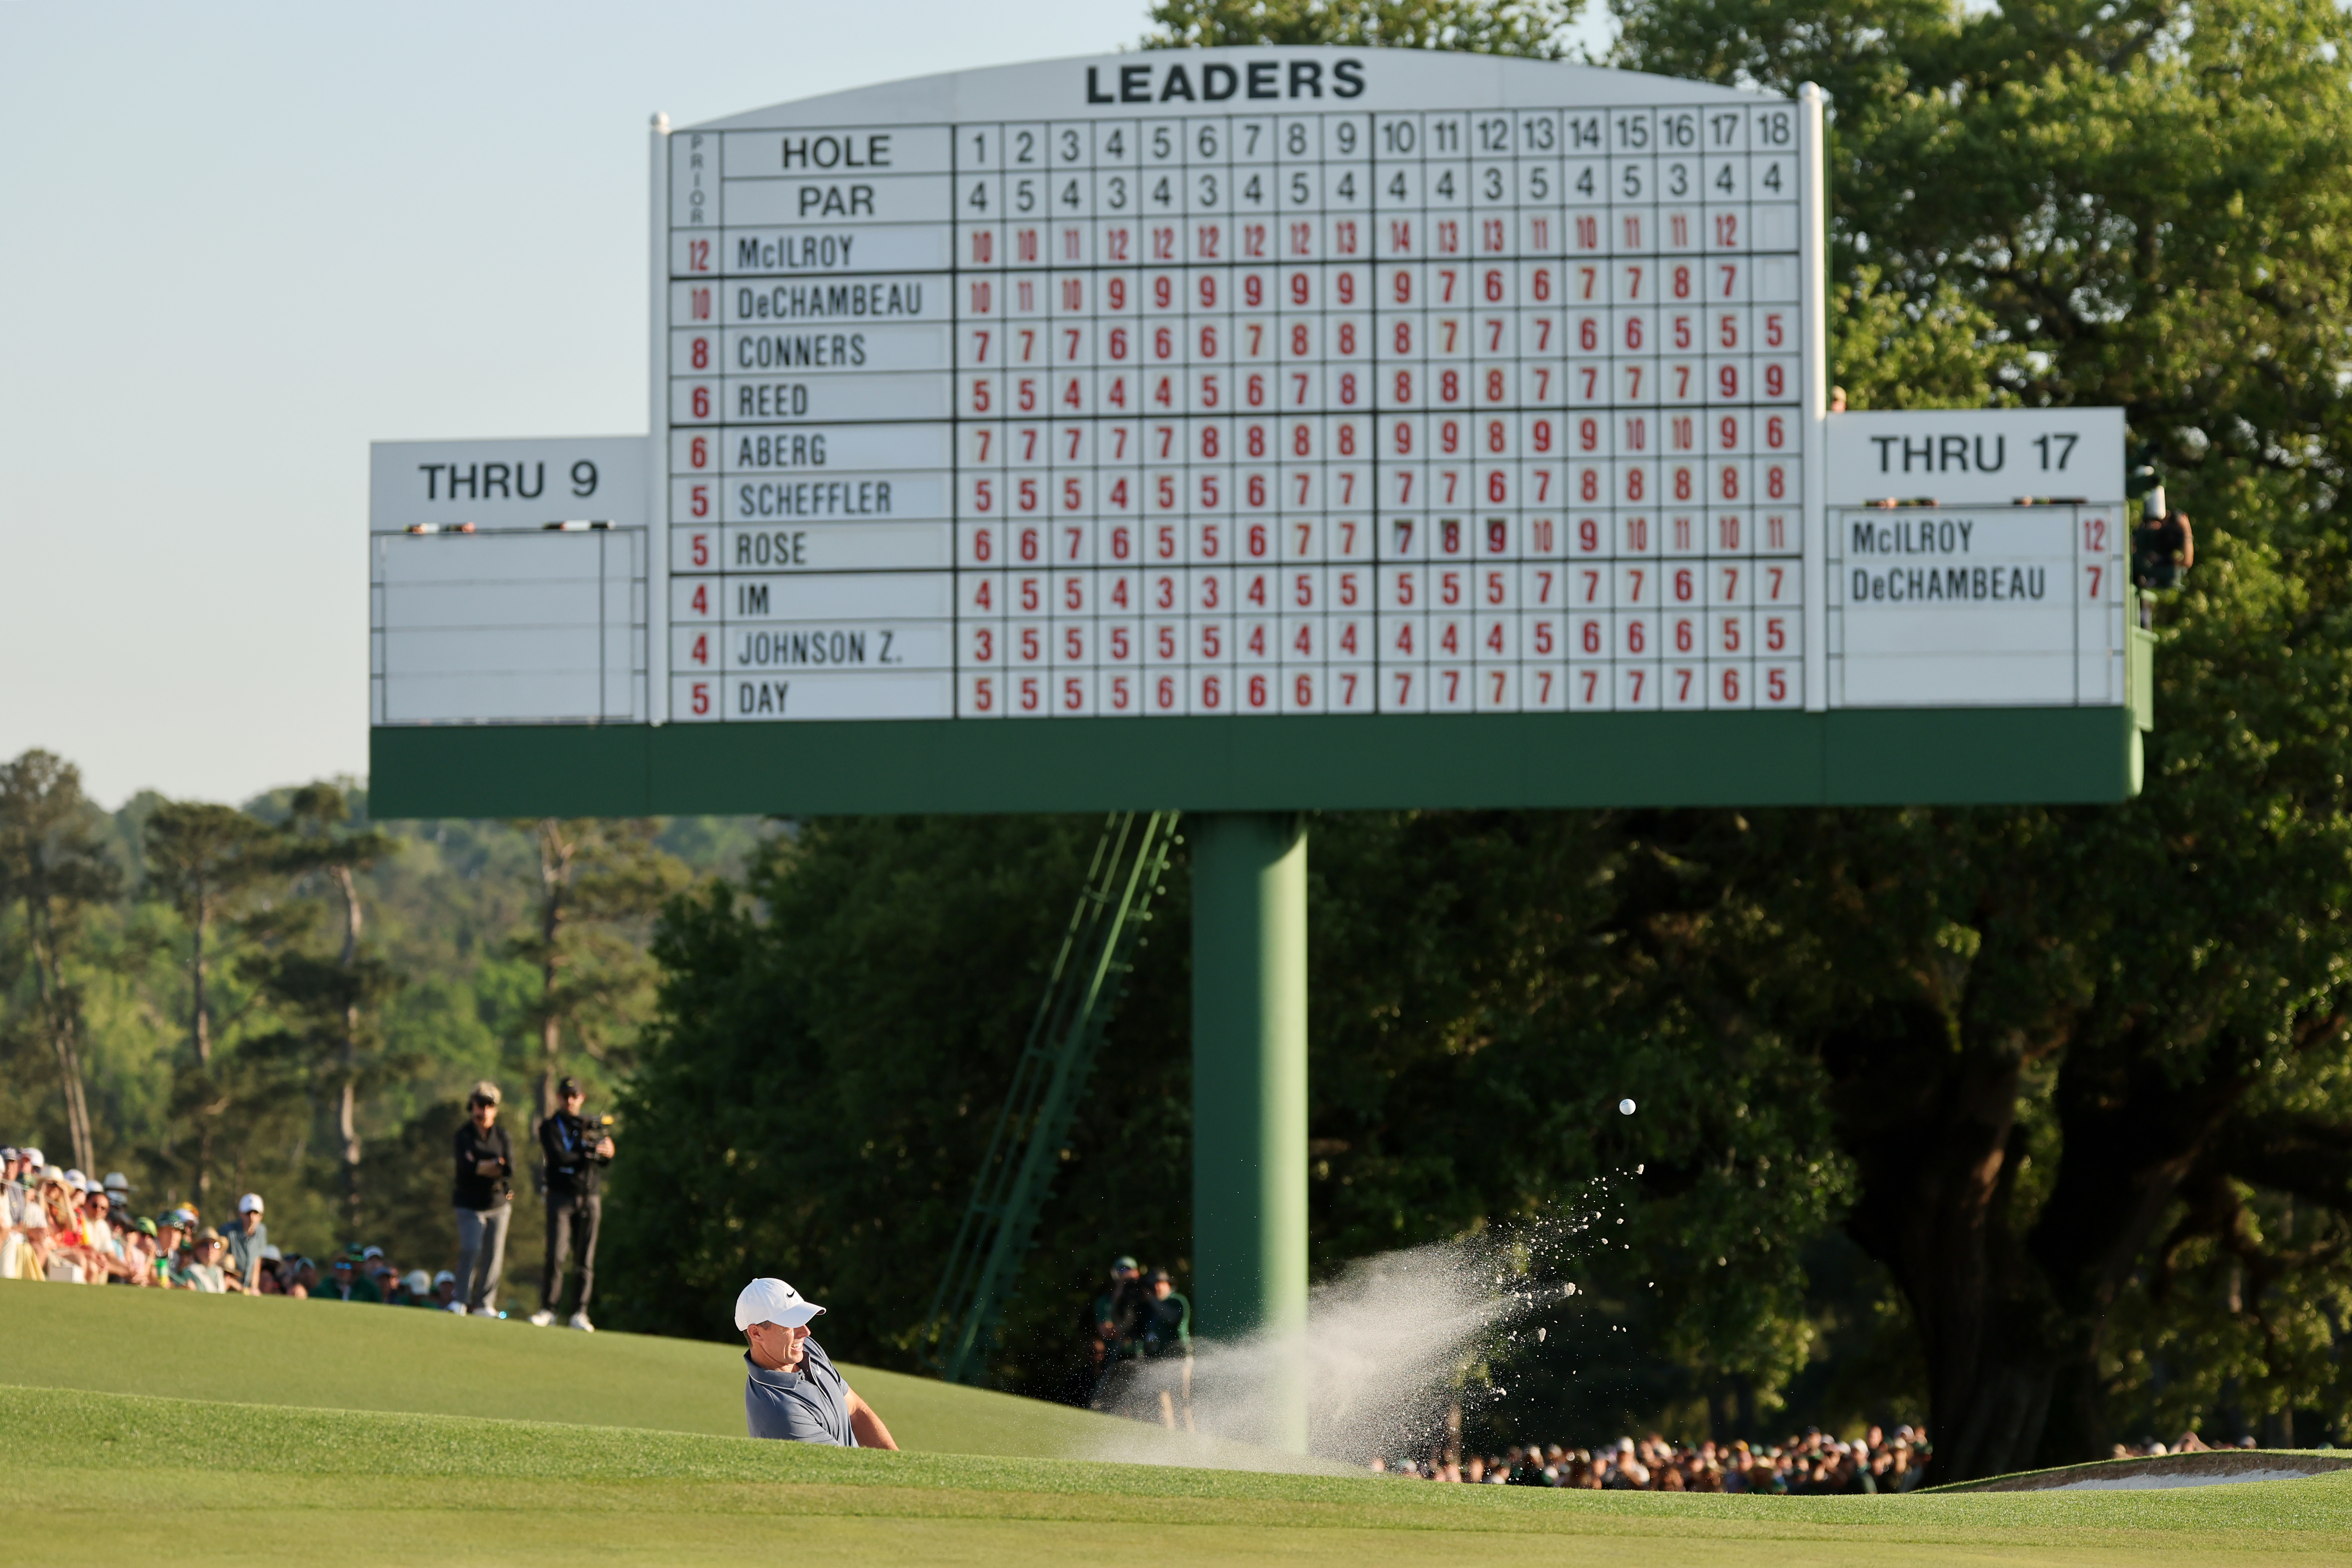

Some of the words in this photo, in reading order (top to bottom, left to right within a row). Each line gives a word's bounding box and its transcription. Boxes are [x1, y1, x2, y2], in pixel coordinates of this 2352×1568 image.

[1087, 60, 1365, 103] LEADERS
[782, 134, 891, 170] HOLE
[973, 133, 985, 163] 1
[1017, 130, 1034, 164] 2
[1061, 129, 1080, 163] 3
[1106, 128, 1125, 159] 4
[1153, 127, 1171, 160] 5
[1198, 125, 1218, 159] 6
[1244, 123, 1262, 156] 7
[1289, 123, 1306, 155] 8
[1337, 121, 1357, 155] 9
[1383, 120, 1415, 153] 10
[1434, 121, 1458, 151] 11
[1478, 118, 1508, 151] 12
[1523, 117, 1554, 151] 13
[1569, 117, 1600, 148] 14
[1616, 115, 1648, 149] 15
[1662, 114, 1695, 147] 16
[1710, 113, 1739, 146] 17
[1758, 112, 1790, 146] 18
[690, 135, 705, 225] PRIOR
[798, 184, 874, 218] PAR
[969, 181, 988, 212] 4
[1017, 179, 1035, 213] 5
[1061, 179, 1080, 209] 4
[1108, 177, 1127, 210] 3
[1152, 176, 1172, 207] 4
[1199, 174, 1218, 207] 3
[1244, 174, 1263, 205] 4
[1292, 173, 1309, 205] 5
[1337, 171, 1356, 202] 4
[1388, 170, 1407, 201] 4
[1436, 169, 1455, 201] 4
[1484, 167, 1503, 201] 3
[1530, 167, 1548, 200] 5
[1576, 166, 1595, 198] 4
[1623, 165, 1642, 198] 5
[1670, 163, 1688, 197] 3
[1715, 163, 1735, 195] 4
[1763, 162, 1782, 194] 4
[690, 240, 709, 271] 12
[738, 235, 853, 269] McILROY
[973, 232, 992, 263] 10
[1018, 230, 1037, 262] 10
[1065, 229, 1079, 259] 11
[1108, 229, 1128, 261] 12
[1154, 228, 1174, 260] 12
[1199, 227, 1219, 258] 12
[1245, 225, 1265, 257] 12
[1291, 223, 1310, 255] 12
[1337, 223, 1356, 254] 13
[1392, 222, 1410, 251] 14
[1439, 222, 1457, 253] 13
[1484, 220, 1504, 252] 13
[1533, 219, 1548, 249] 11
[1578, 217, 1596, 249] 10
[1625, 218, 1640, 248] 11
[1672, 217, 1687, 247] 11
[1716, 215, 1736, 247] 12
[692, 289, 710, 319] 10
[738, 283, 921, 320] DeCHAMBEAU
[971, 282, 991, 313] 10
[1018, 281, 1033, 311] 11
[1063, 280, 1081, 310] 10
[1108, 278, 1126, 310] 9
[1154, 276, 1172, 308] 9
[1199, 275, 1216, 308] 9
[1244, 275, 1263, 307] 9
[1291, 273, 1309, 305] 9
[1336, 273, 1354, 304] 9
[1394, 272, 1411, 304] 9
[1439, 271, 1456, 302] 7
[1485, 270, 1503, 302] 6
[1533, 269, 1550, 301] 6
[1580, 268, 1595, 299] 7
[1626, 267, 1642, 298] 7
[1673, 266, 1689, 298] 8
[1720, 265, 1737, 296] 7
[691, 338, 709, 369] 8
[738, 334, 866, 369] CONNERS
[974, 332, 989, 362] 7
[1019, 330, 1034, 361] 7
[1064, 329, 1080, 359] 7
[1108, 328, 1128, 360] 6
[1154, 328, 1172, 359] 6
[1200, 326, 1217, 358] 6
[1246, 325, 1262, 355] 7
[1291, 324, 1308, 356] 8
[1338, 323, 1355, 355] 8
[1394, 322, 1411, 354] 8
[1442, 321, 1457, 352] 7
[1486, 320, 1503, 351] 7
[1534, 319, 1551, 350] 7
[1580, 319, 1597, 351] 6
[1626, 317, 1643, 350] 6
[1674, 317, 1691, 349] 5
[1720, 316, 1737, 347] 5
[1766, 314, 1783, 347] 5
[692, 387, 710, 419] 6
[739, 384, 808, 417] REED
[690, 437, 707, 468] 6
[738, 434, 826, 468] ABERG
[1870, 435, 2004, 473] THRU
[2033, 434, 2079, 470] 17
[419, 462, 544, 500] THRU
[570, 459, 599, 499] 9
[691, 486, 708, 517] 5
[740, 481, 891, 517] SCHEFFLER
[692, 534, 709, 567] 5
[737, 532, 806, 565] ROSE
[1295, 524, 1311, 555] 7
[1340, 523, 1355, 553] 7
[1398, 524, 1412, 553] 7
[1443, 523, 1459, 554] 8
[1488, 521, 1506, 554] 9
[1534, 520, 1552, 552] 10
[1579, 520, 1598, 552] 9
[1628, 519, 1647, 550] 10
[1675, 519, 1689, 548] 11
[1720, 517, 1739, 549] 10
[1769, 518, 1783, 546] 11
[1852, 520, 1972, 554] McILROY
[2084, 520, 2105, 552] 12
[691, 585, 708, 615] 4
[738, 583, 769, 616] IM
[1853, 567, 2045, 602] DeCHAMBEAU
[2085, 566, 2102, 598] 7
[692, 634, 708, 664] 4
[738, 631, 865, 665] JOHNSON
[879, 629, 901, 664] Z.
[692, 683, 710, 715] 5
[739, 681, 789, 714] DAY
[975, 679, 992, 711] 5
[1021, 679, 1039, 710] 5
[1065, 678, 1083, 710] 5
[1112, 677, 1129, 709] 5
[1157, 677, 1174, 708] 6
[1202, 676, 1221, 708] 6
[1248, 675, 1267, 708] 6
[1295, 675, 1312, 706] 6
[1340, 674, 1357, 705] 7
[1395, 673, 1411, 704] 7
[1442, 671, 1459, 702] 7
[1490, 672, 1505, 703] 7
[1538, 672, 1552, 703] 7
[1581, 671, 1597, 702] 7
[1628, 671, 1644, 702] 7
[1676, 669, 1692, 701] 7
[1722, 669, 1739, 701] 6
[1768, 669, 1786, 701] 5
